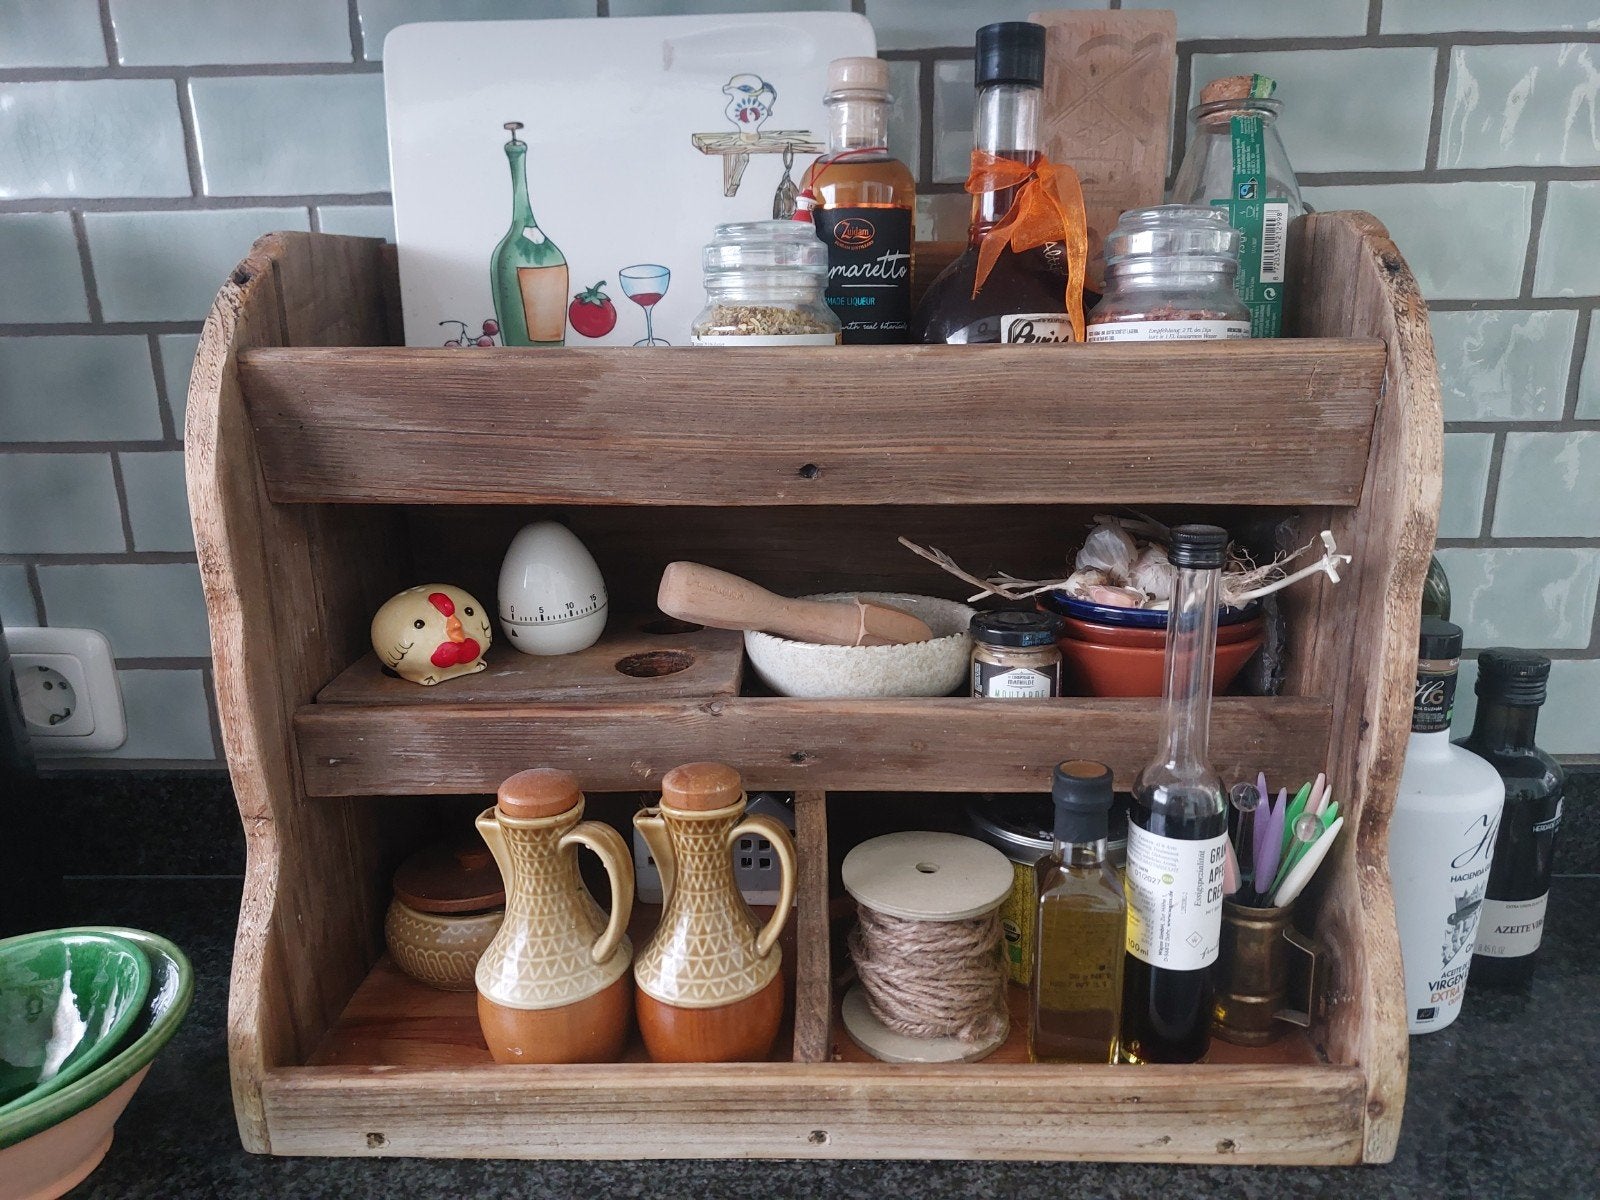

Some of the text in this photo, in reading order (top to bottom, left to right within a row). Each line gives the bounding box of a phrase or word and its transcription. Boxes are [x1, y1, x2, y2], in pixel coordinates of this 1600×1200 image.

[840, 221, 870, 239] Zuidam
[828, 249, 911, 279] maretto
[825, 297, 876, 306] MADE LIQUEUR
[510, 605, 515, 613] 0
[565, 602, 574, 610] 10
[590, 593, 597, 601] 15
[1494, 924, 1532, 934] AZEITE
[1140, 949, 1149, 957] ml
[1428, 974, 1464, 992] VIRGEN
[1430, 985, 1460, 1004] EXTRA
